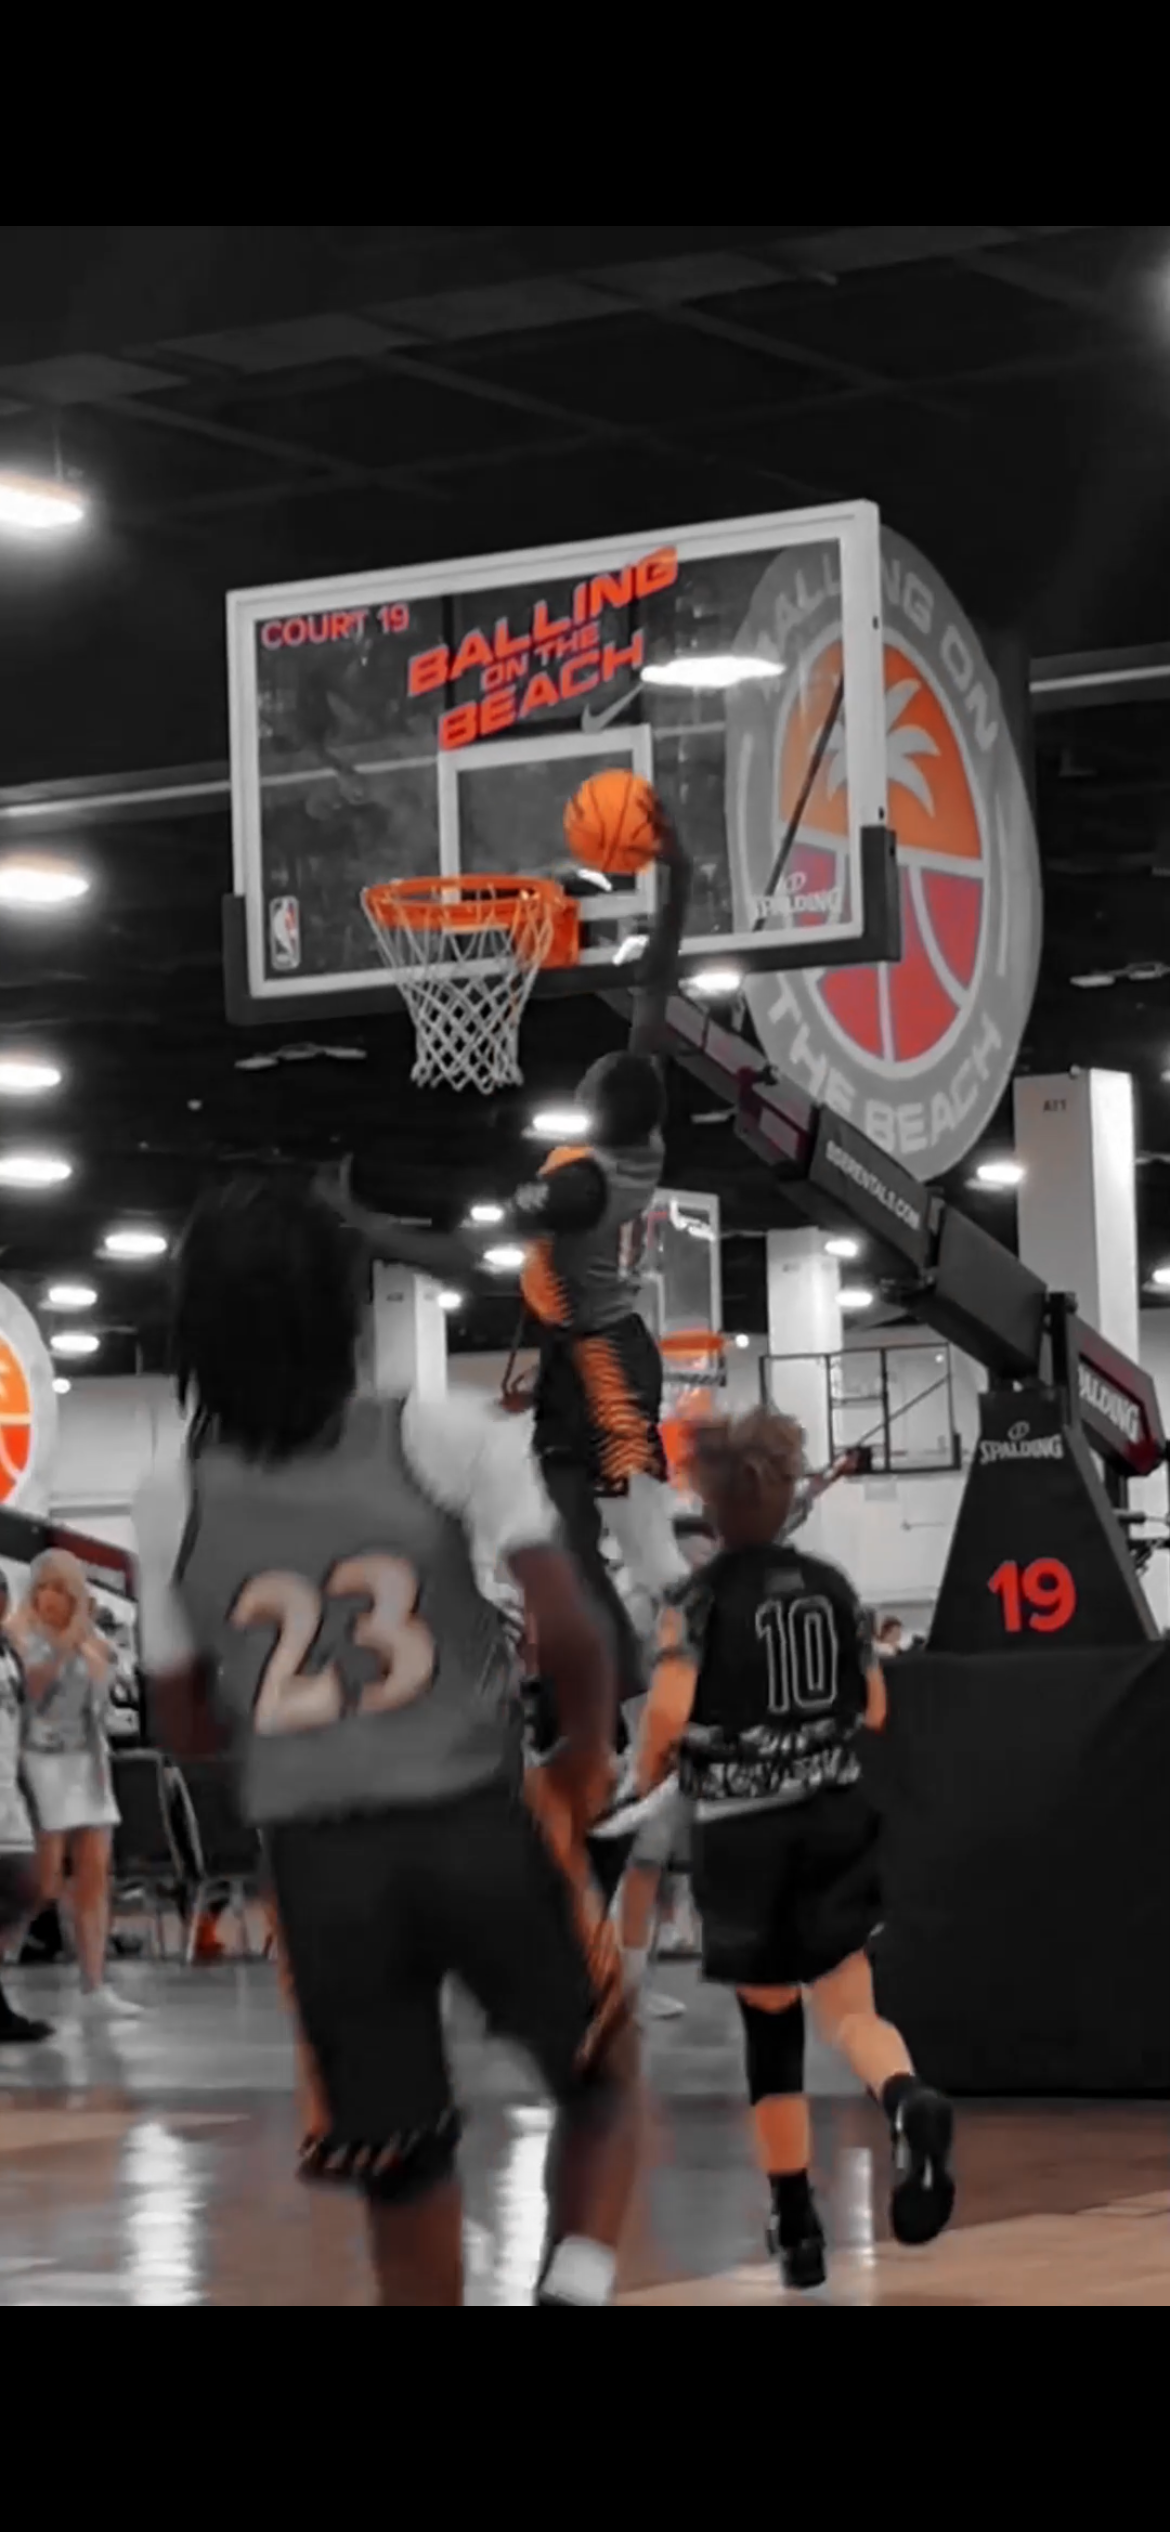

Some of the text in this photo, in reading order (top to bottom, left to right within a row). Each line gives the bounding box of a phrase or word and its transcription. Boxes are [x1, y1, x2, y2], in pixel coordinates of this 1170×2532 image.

[262, 602, 409, 649] COURT 19
[408, 546, 678, 697] BALLING
[481, 622, 600, 693] ON THE
[439, 629, 645, 752] BEACH
[940, 624, 998, 751] ON
[864, 1011, 1001, 1153] BEACH
[979, 1433, 1064, 1464] SPALDING
[228, 1550, 438, 1735] 23
[755, 1595, 838, 1714] 10
[987, 1557, 1077, 1633] 19
